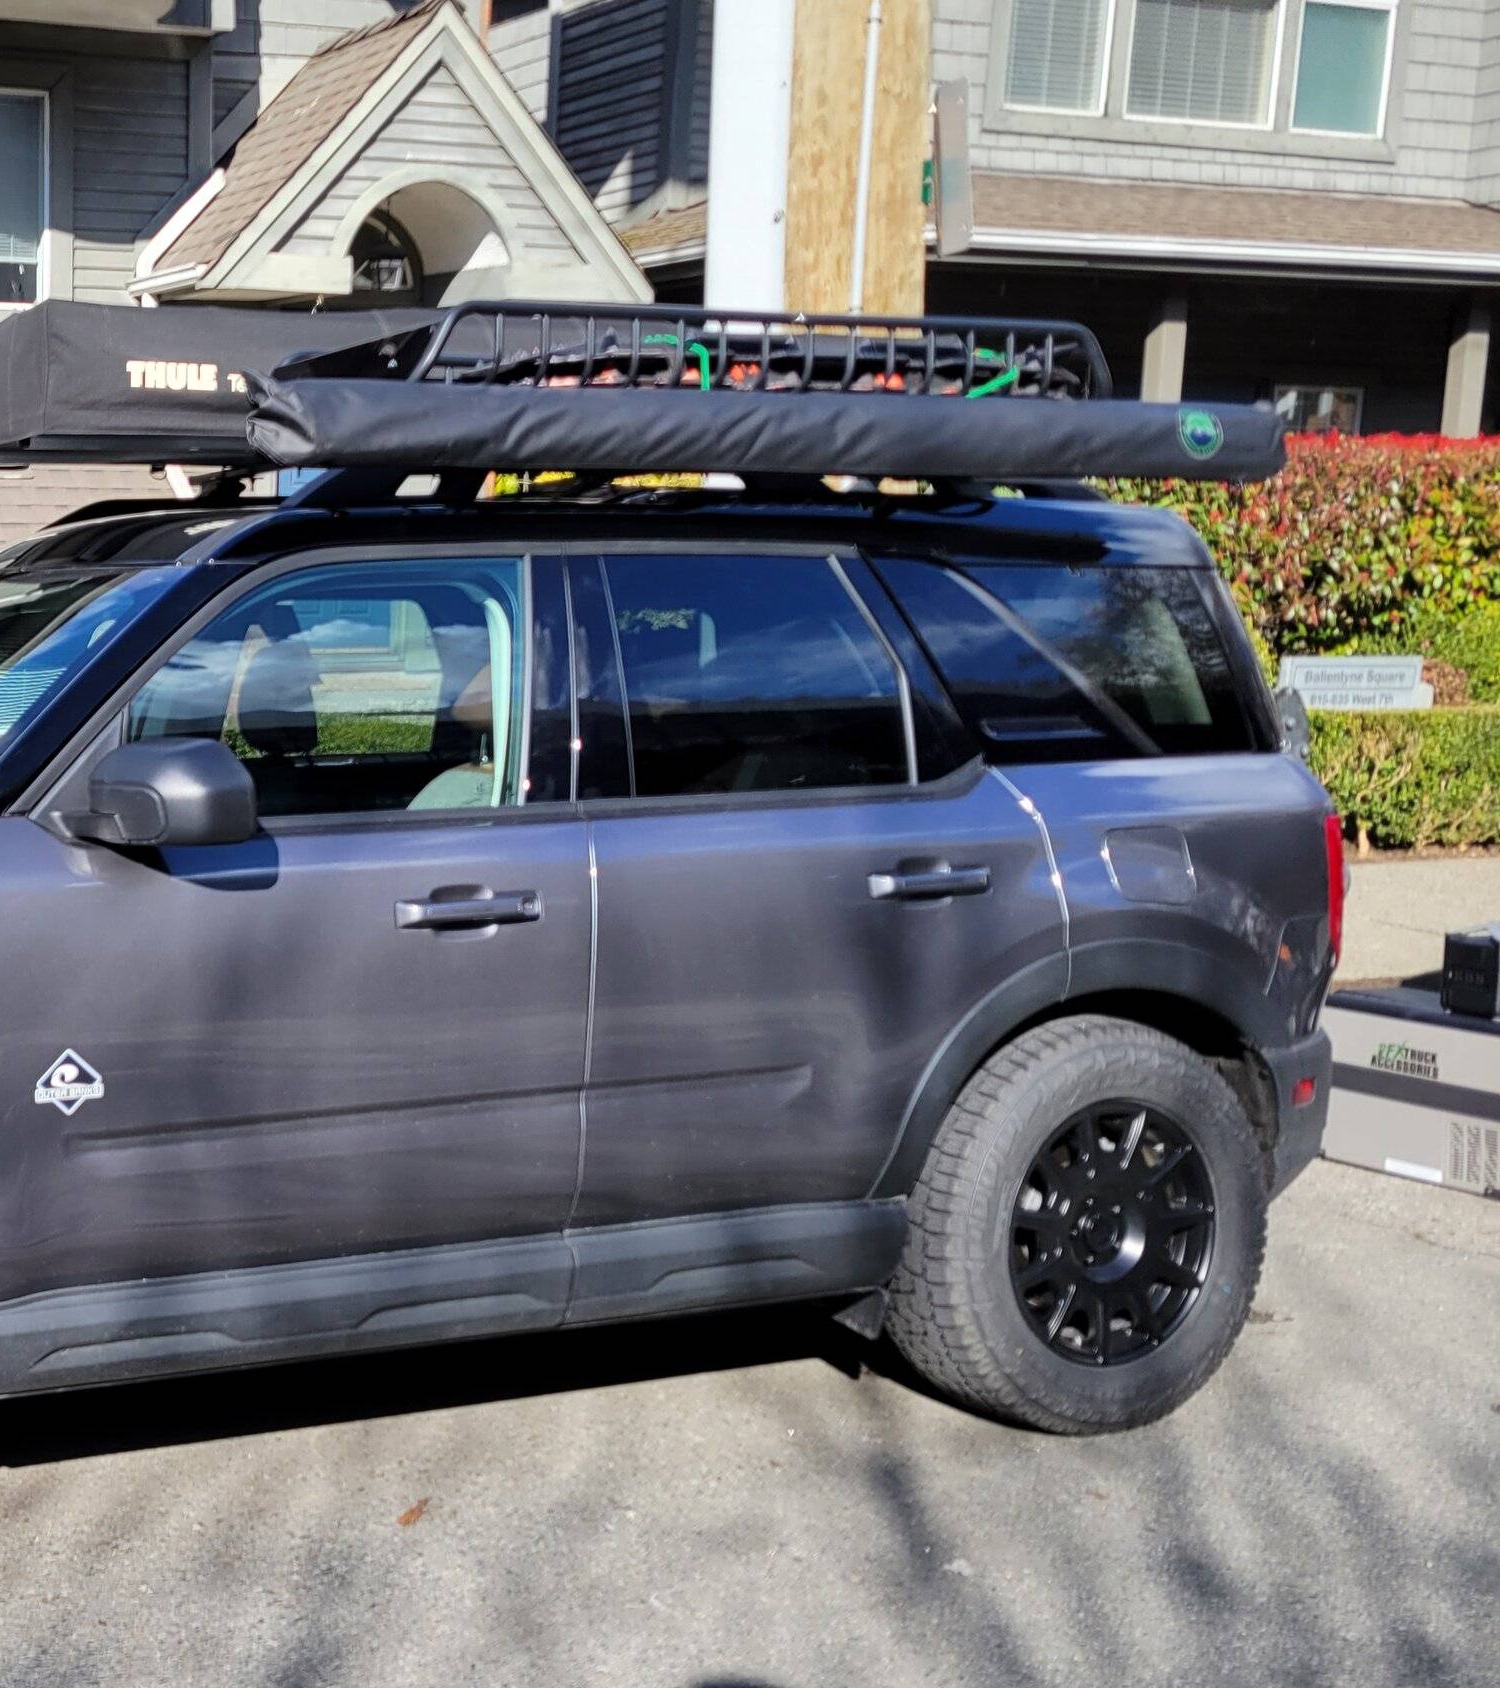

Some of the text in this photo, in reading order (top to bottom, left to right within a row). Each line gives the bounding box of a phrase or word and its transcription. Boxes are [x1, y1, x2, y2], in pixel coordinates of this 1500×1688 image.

[126, 360, 218, 390] THULE
[1367, 669, 1406, 687] Square
[1352, 693, 1376, 706] West
[1405, 1047, 1437, 1065] TRUCK
[1371, 1055, 1438, 1079] ACCESSORIES
